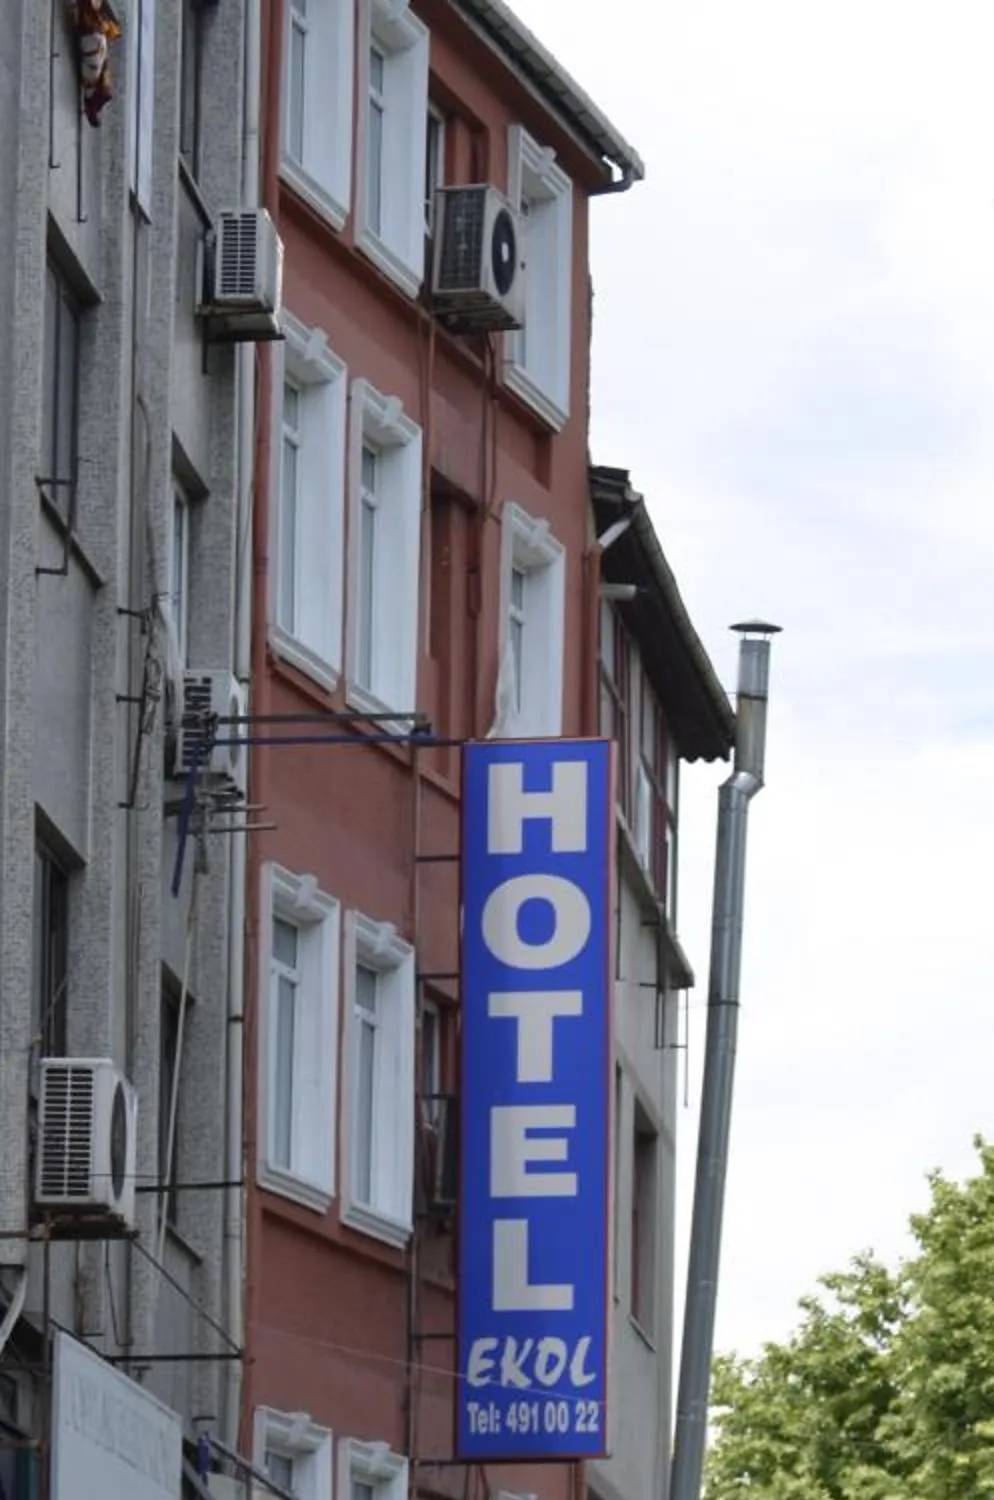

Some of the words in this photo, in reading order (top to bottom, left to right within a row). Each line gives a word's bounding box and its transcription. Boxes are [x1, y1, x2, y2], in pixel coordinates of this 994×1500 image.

[481, 761, 591, 1312] HOTEL
[466, 1336, 597, 1389] EKOL
[467, 1401, 501, 1434] Tel:
[505, 1401, 539, 1434] 491
[544, 1401, 570, 1434] 00
[575, 1400, 599, 1433] 22
